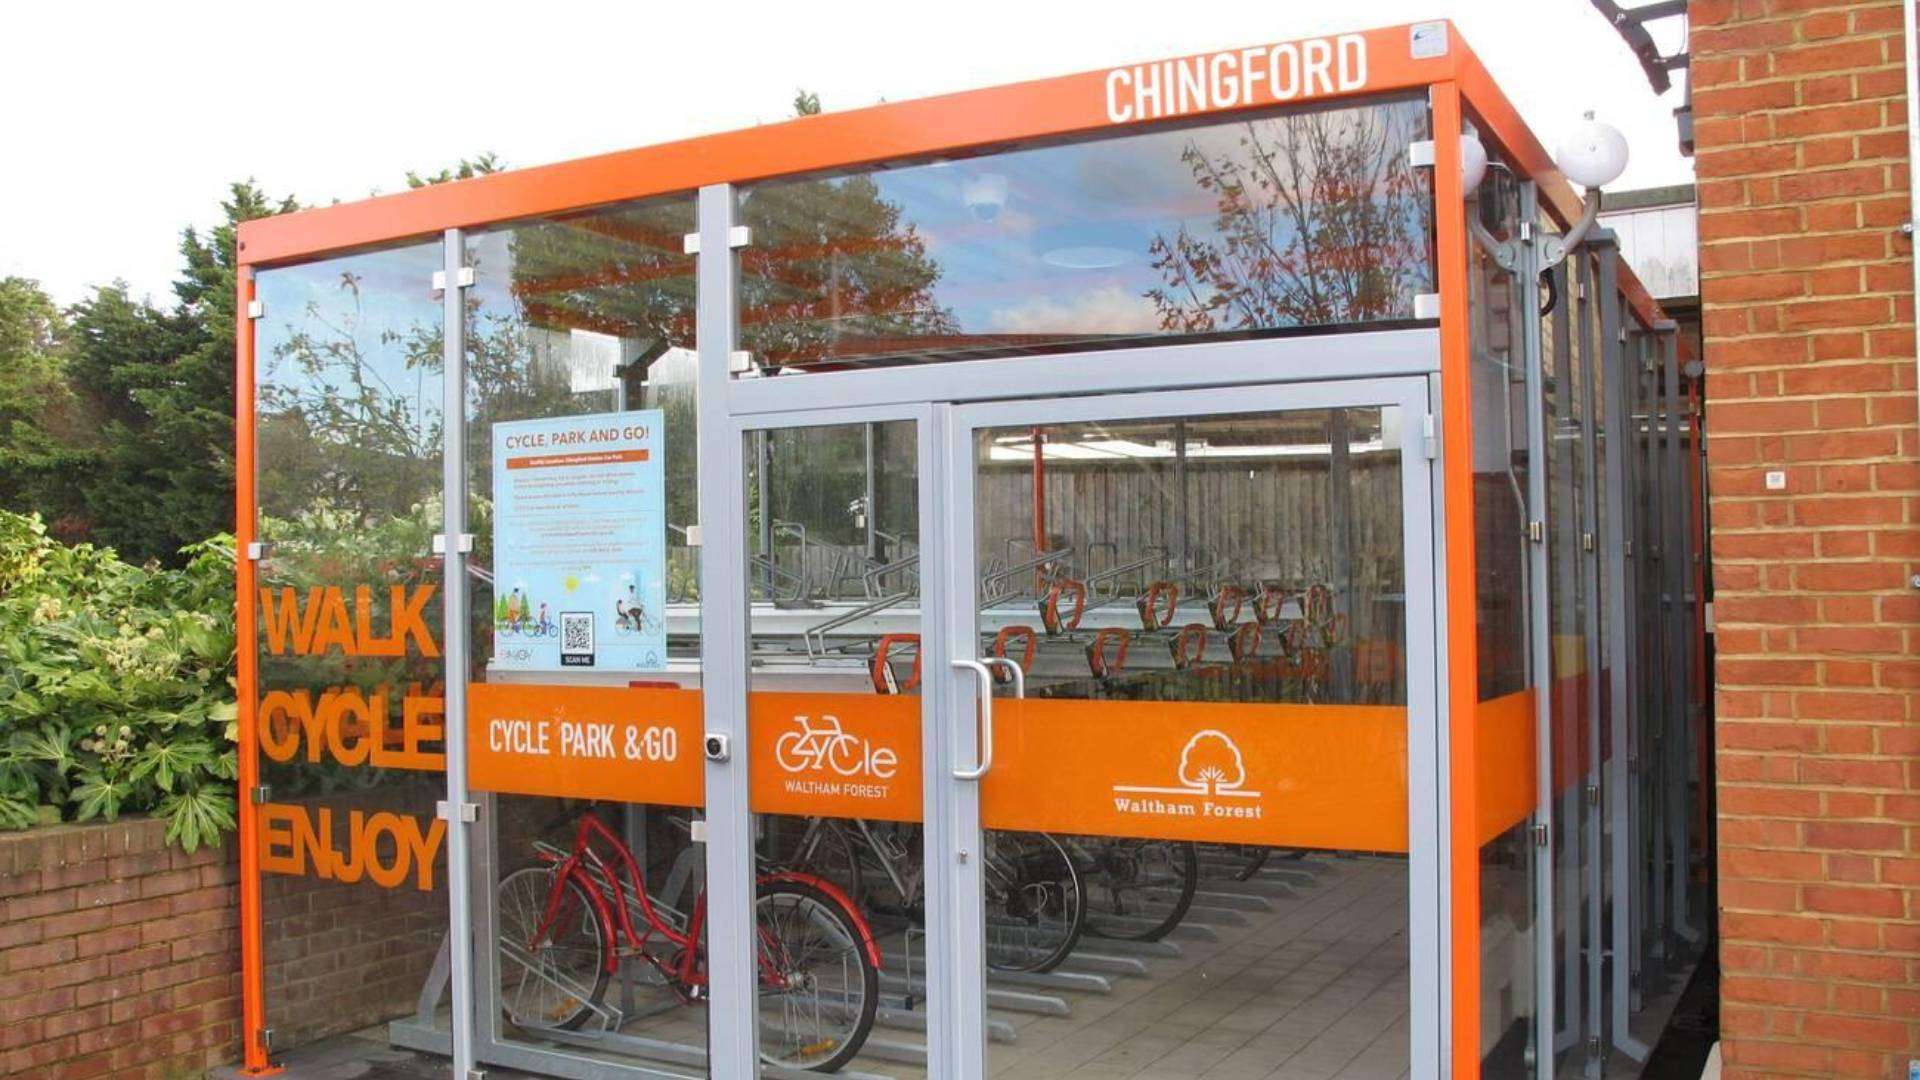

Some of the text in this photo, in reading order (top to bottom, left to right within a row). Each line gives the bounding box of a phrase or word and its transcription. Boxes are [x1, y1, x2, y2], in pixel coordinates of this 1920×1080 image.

[1105, 33, 1367, 124] CHINGFORD
[551, 430, 586, 446] PARK
[589, 428, 620, 443] AND
[622, 425, 650, 441] GO!
[260, 583, 438, 658] WALK
[564, 655, 591, 665] SCAN ME
[259, 688, 446, 772] CYCLE
[489, 719, 678, 763] CYCLE PARK & GO
[785, 779, 889, 799] WALTHAM FOREST
[1114, 797, 1263, 819] Waltham Forest
[260, 803, 447, 892] ENJOY
